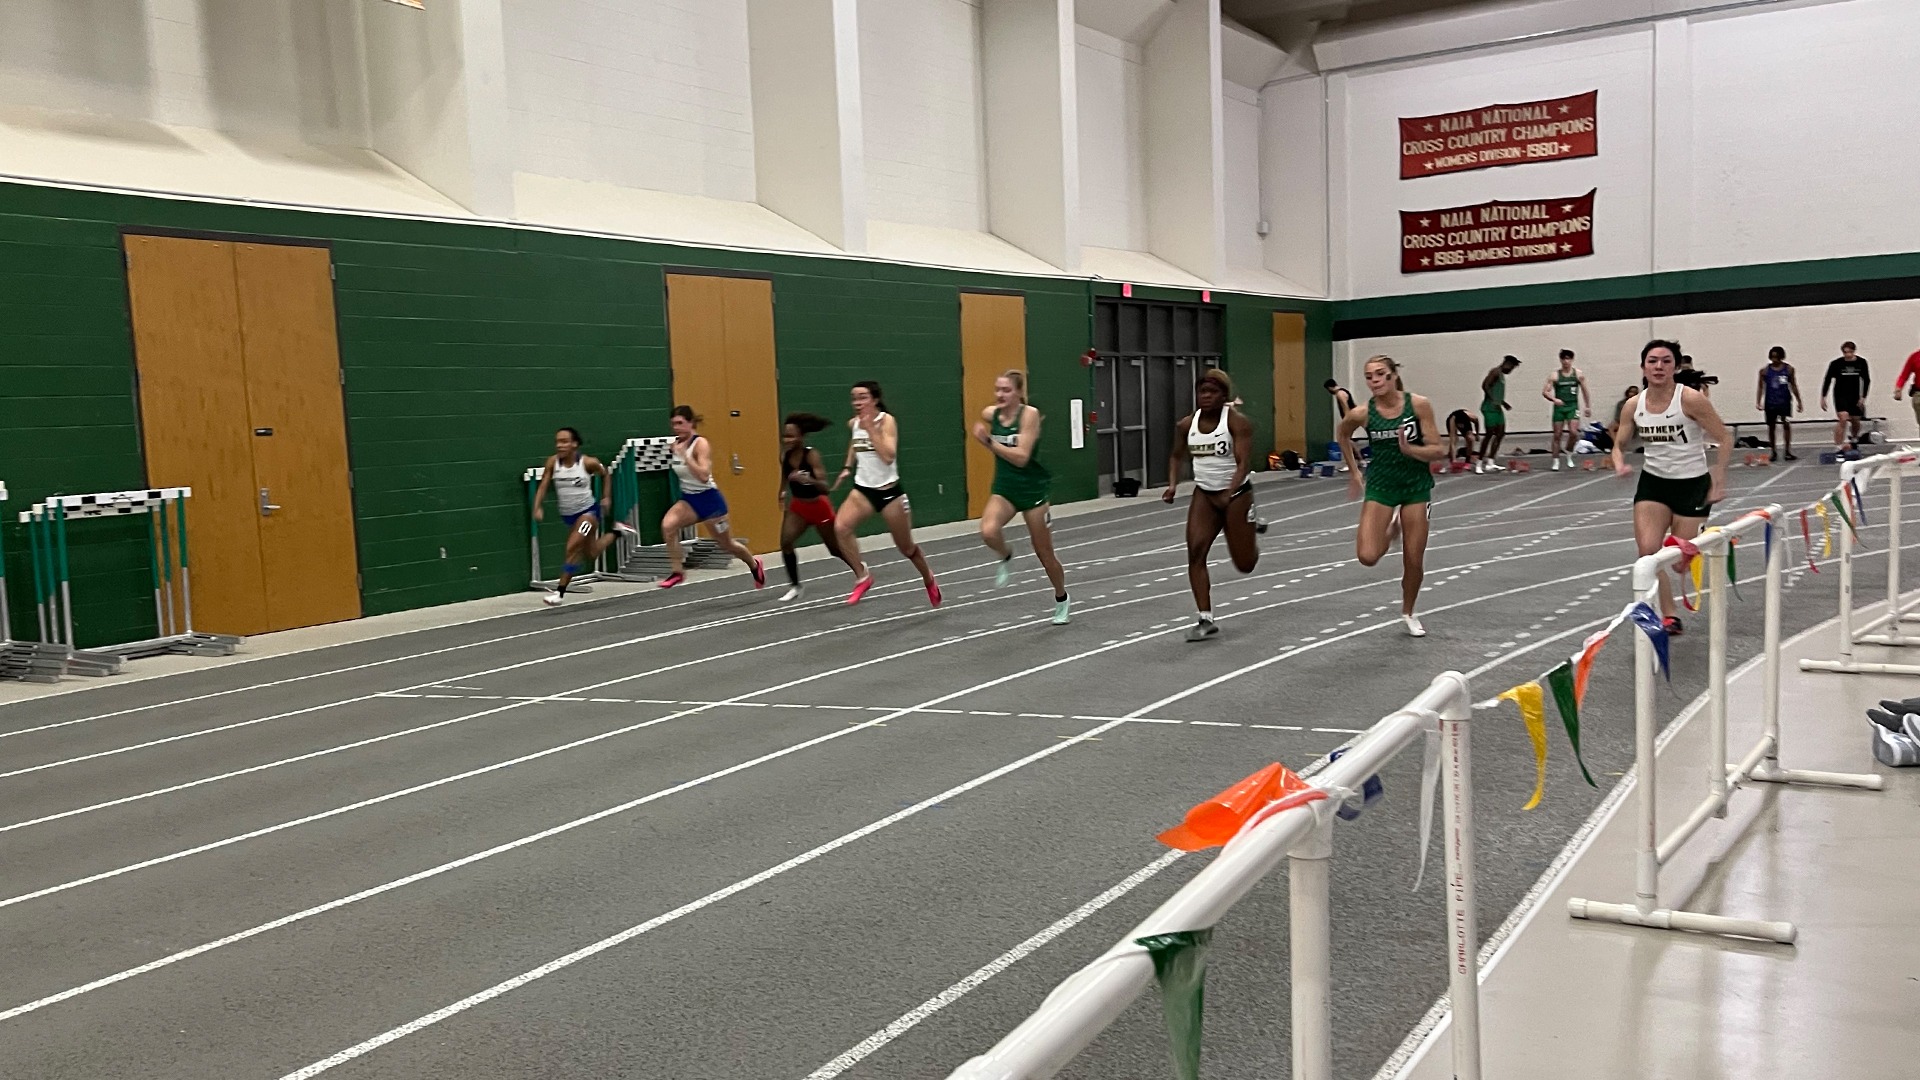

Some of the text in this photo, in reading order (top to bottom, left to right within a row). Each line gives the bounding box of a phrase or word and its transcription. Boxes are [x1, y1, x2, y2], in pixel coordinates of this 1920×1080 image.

[1440, 105, 1552, 133] NAIA NATIONAL
[1403, 116, 1595, 156] CROSS COUNTRY CHAMPIONS
[1440, 204, 1550, 229] NAIA NATIONAL
[1403, 216, 1591, 249] CROSS COUNTRY CHAMPIONS
[1513, 242, 1557, 258] DIVISION
[1404, 423, 1416, 441] 2
[1677, 429, 1688, 444] 1
[1216, 440, 1228, 456] 3
[1453, 871, 1465, 901] PIPE
[1455, 908, 1467, 975] CHARLOTTE
